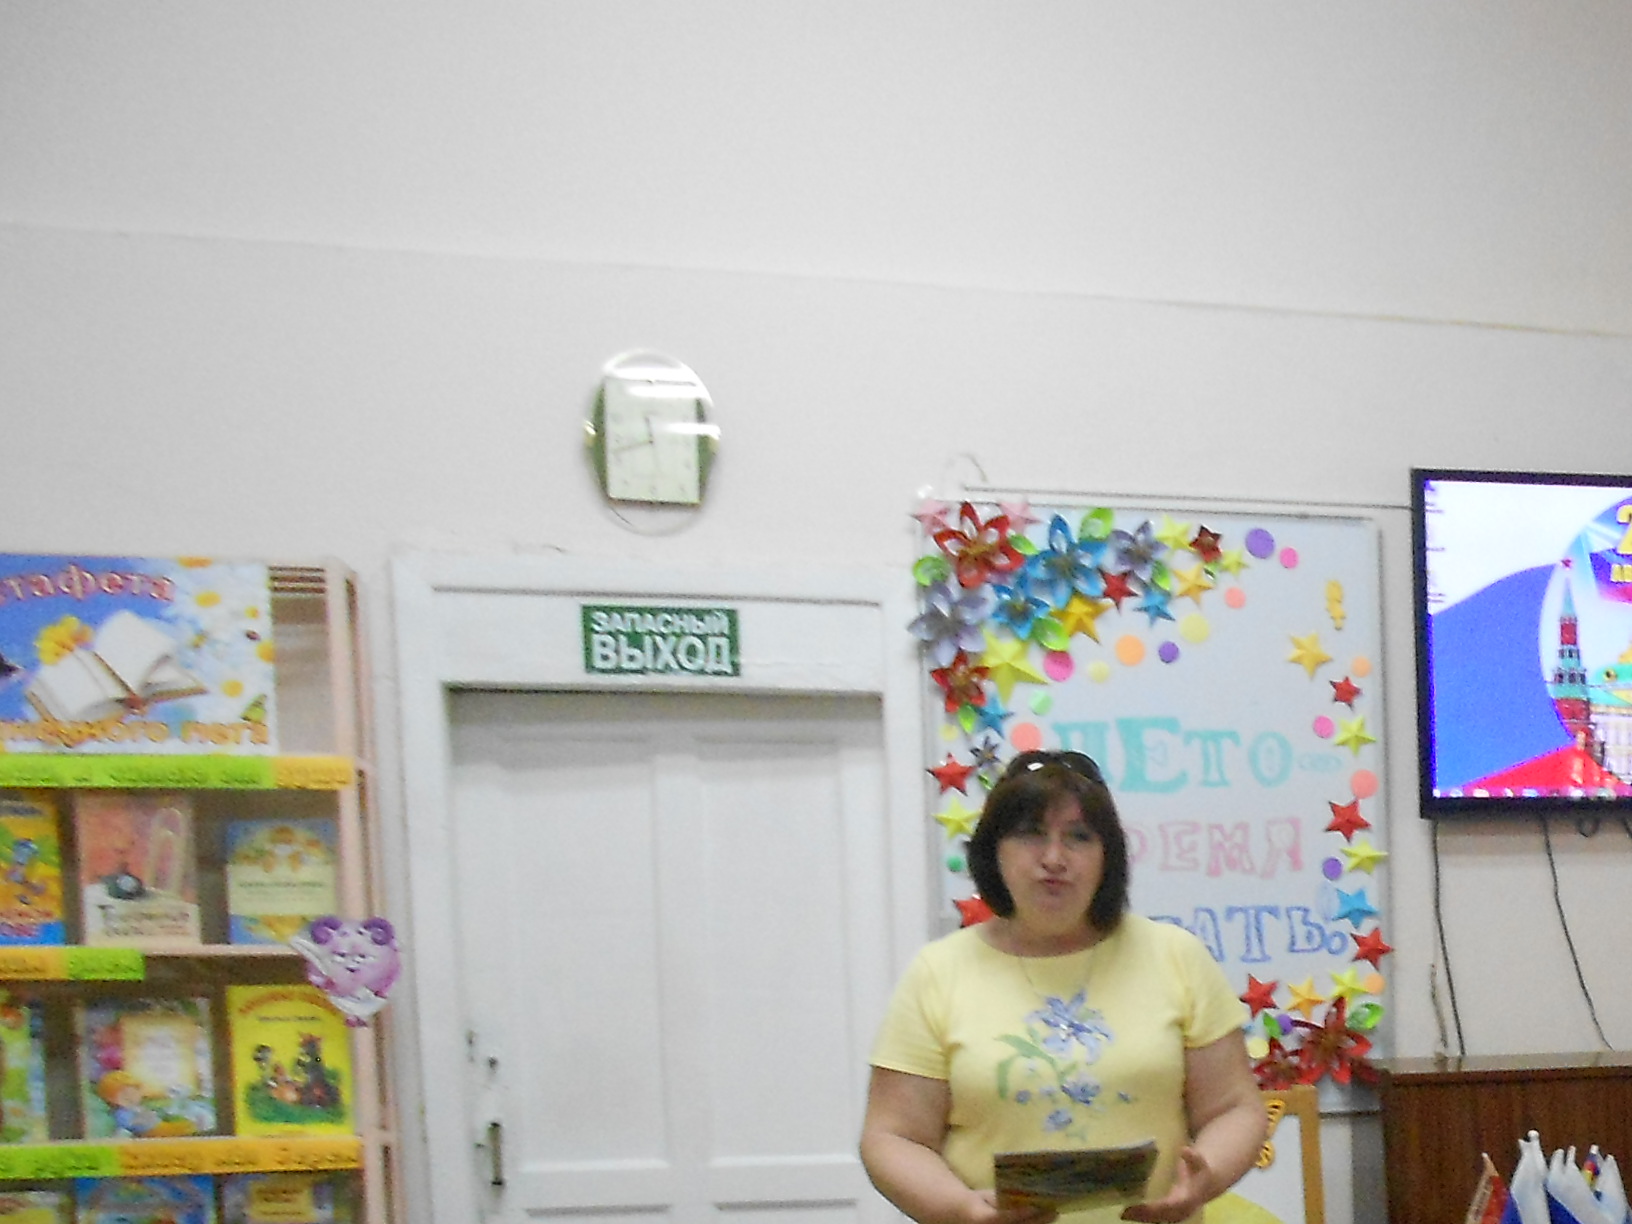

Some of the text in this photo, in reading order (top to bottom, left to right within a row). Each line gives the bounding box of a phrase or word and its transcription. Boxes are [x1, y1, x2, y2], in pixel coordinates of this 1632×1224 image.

[0, 562, 176, 603] тафета
[590, 610, 730, 635] ЗАПАСНЫЙ
[591, 634, 732, 674] ВЫХОД
